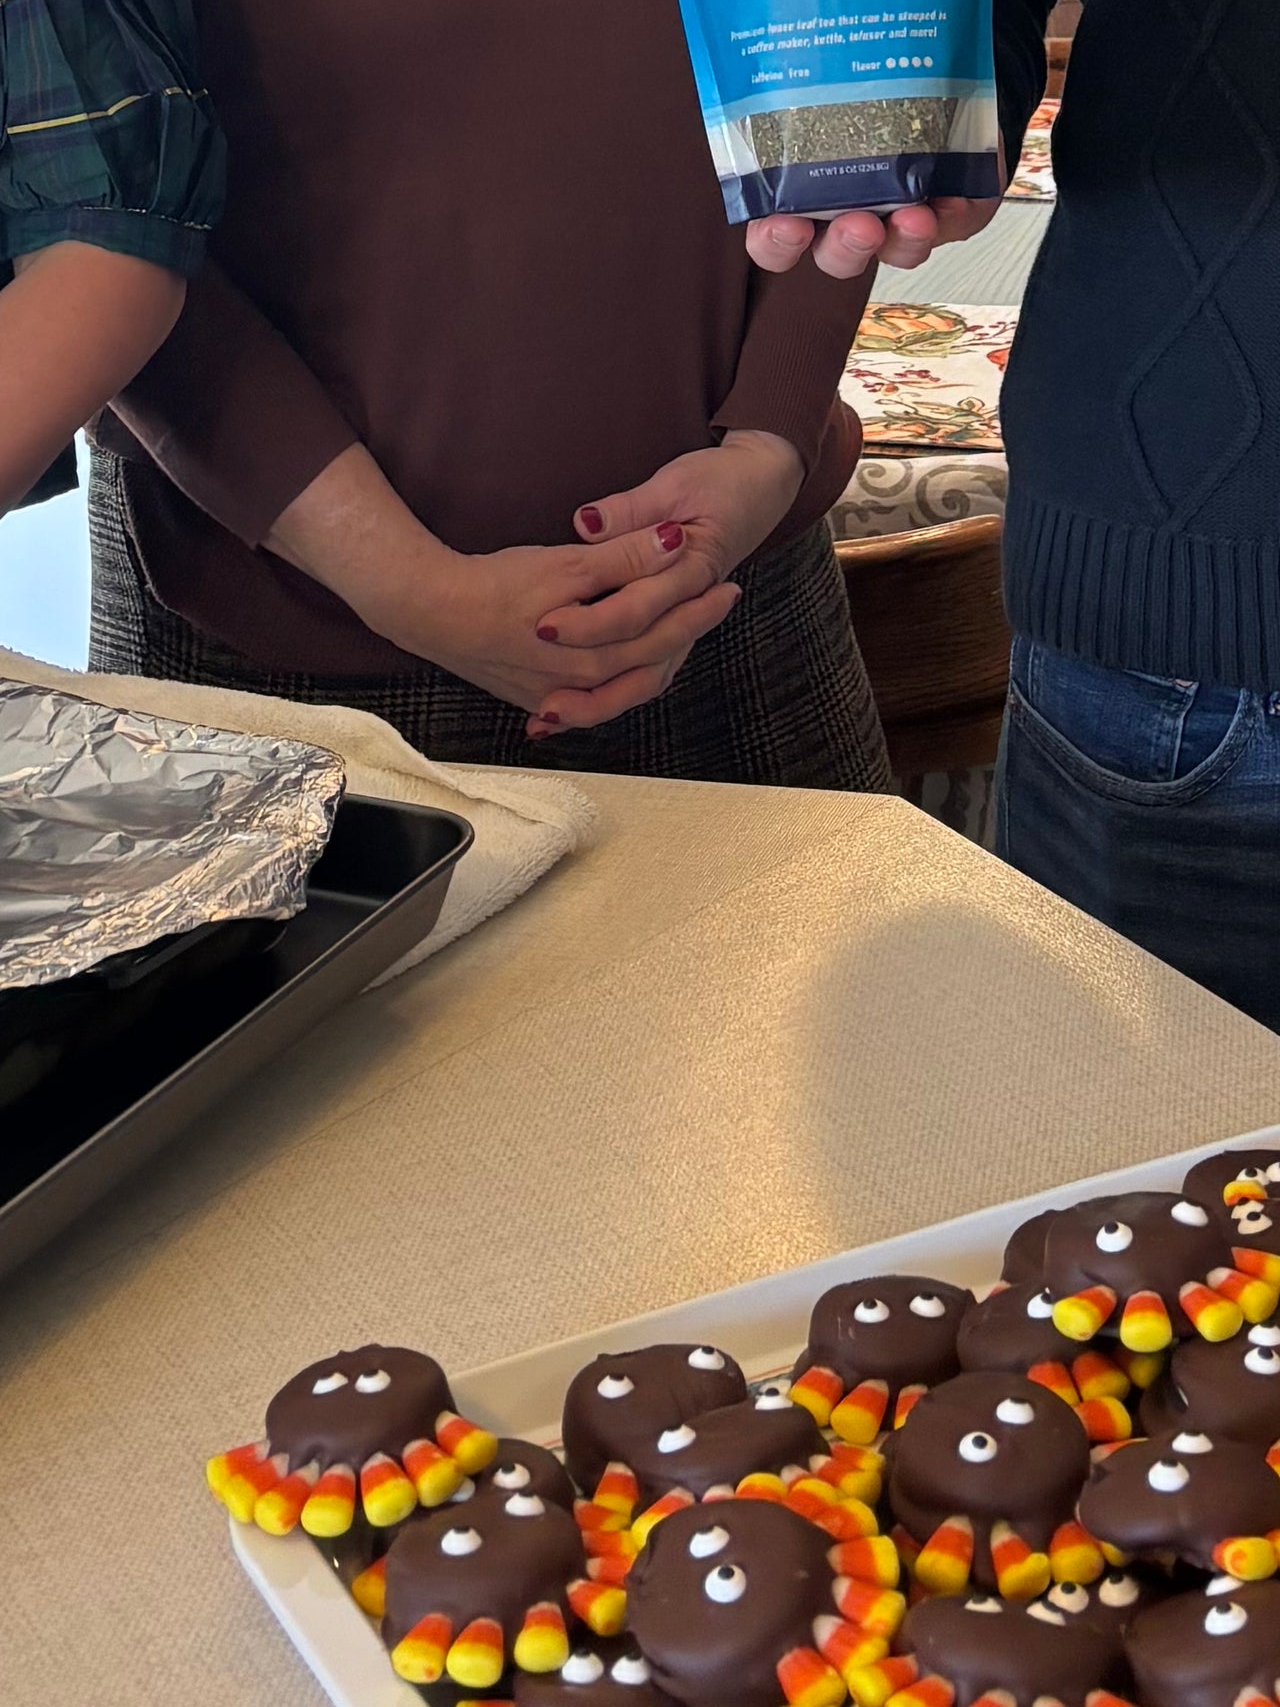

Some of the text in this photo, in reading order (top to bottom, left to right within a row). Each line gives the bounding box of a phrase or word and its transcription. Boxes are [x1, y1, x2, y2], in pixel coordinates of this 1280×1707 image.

[796, 17, 817, 30] leaf
[818, 18, 836, 28] tea
[838, 14, 859, 26] that
[861, 14, 880, 24] can
[882, 11, 895, 23] be
[898, 9, 937, 23] steeped
[747, 41, 775, 55] coffee
[777, 37, 811, 49] maker,
[813, 32, 846, 46] kettle,
[849, 30, 886, 42] infuser
[888, 27, 908, 38] and
[909, 26, 937, 38] more!
